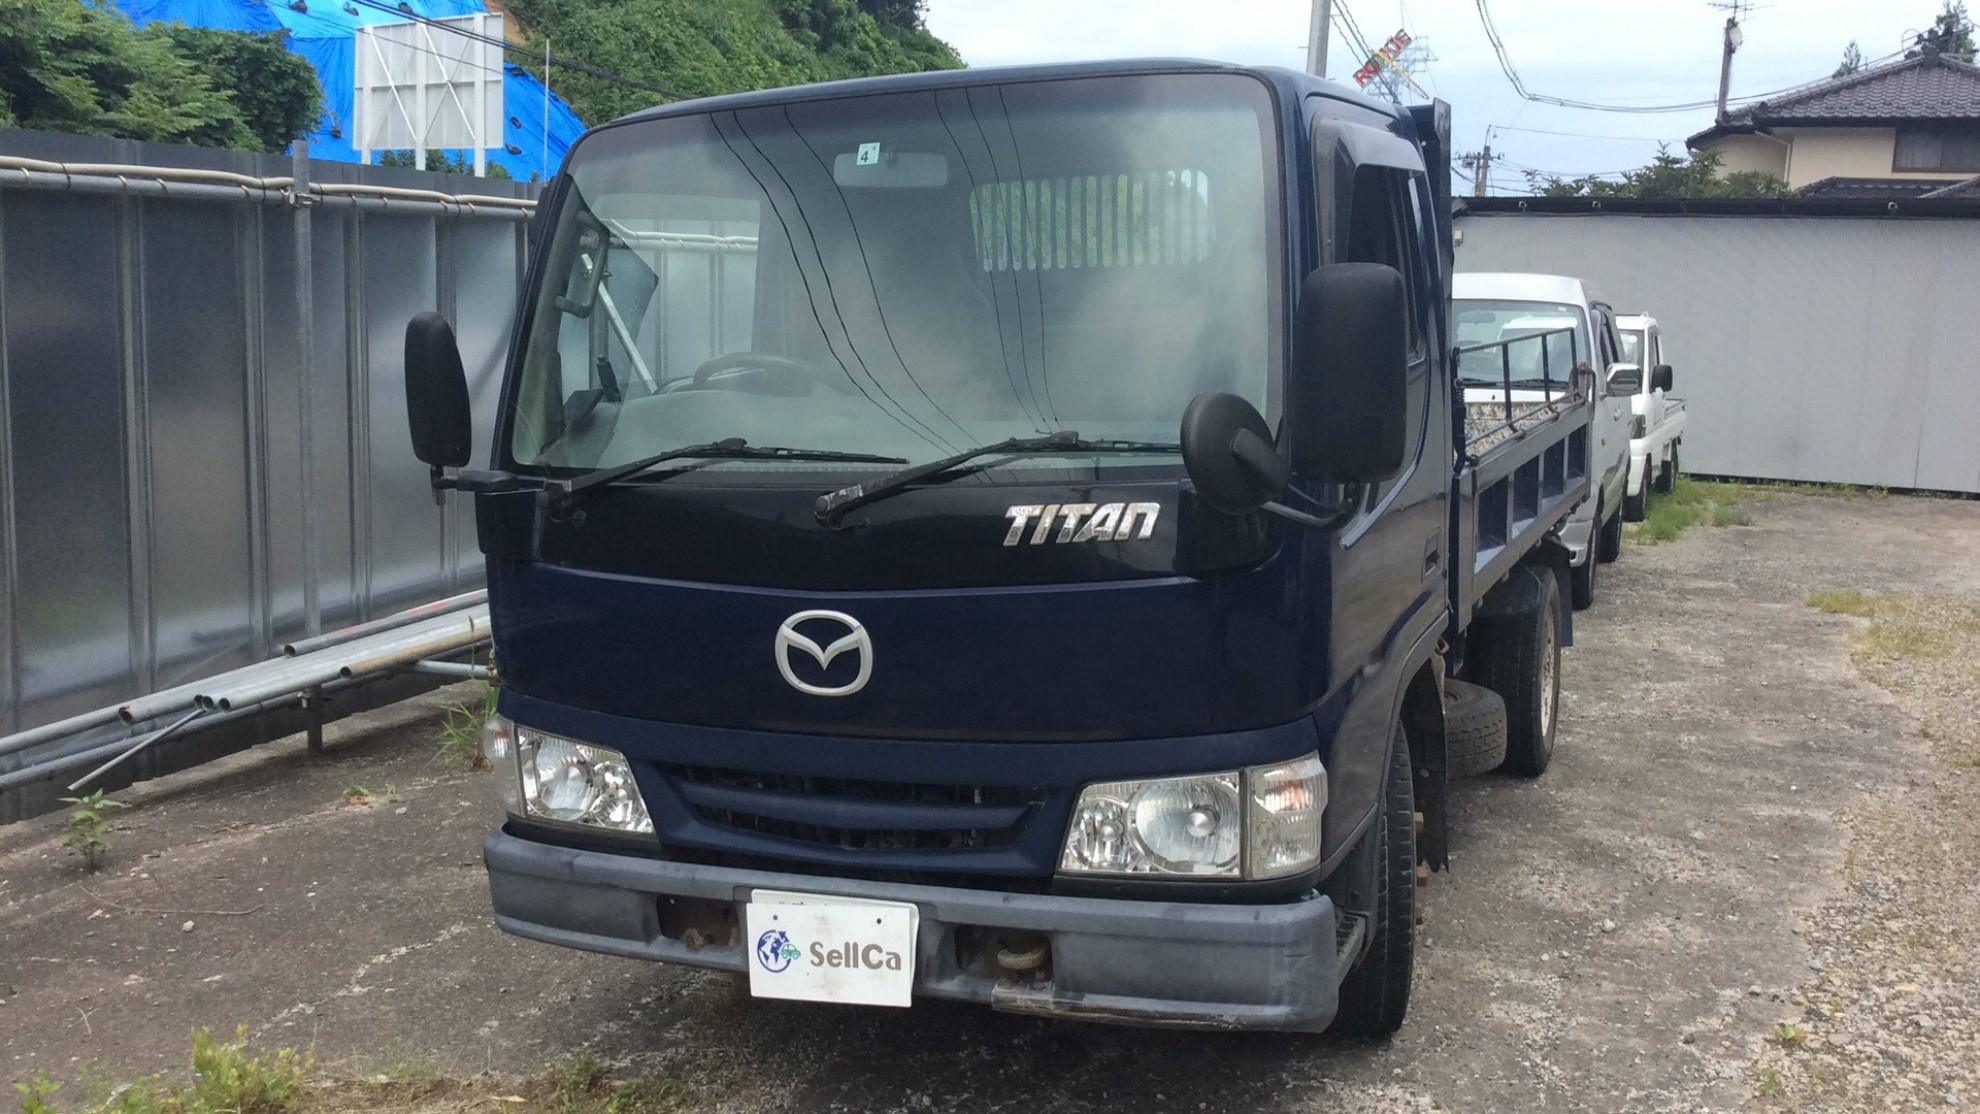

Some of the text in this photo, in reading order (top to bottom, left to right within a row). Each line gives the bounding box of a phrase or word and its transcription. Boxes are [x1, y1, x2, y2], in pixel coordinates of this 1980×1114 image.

[861, 150, 869, 163] 4
[1003, 502, 1161, 546] TITAN
[809, 941, 902, 971] SellCa
